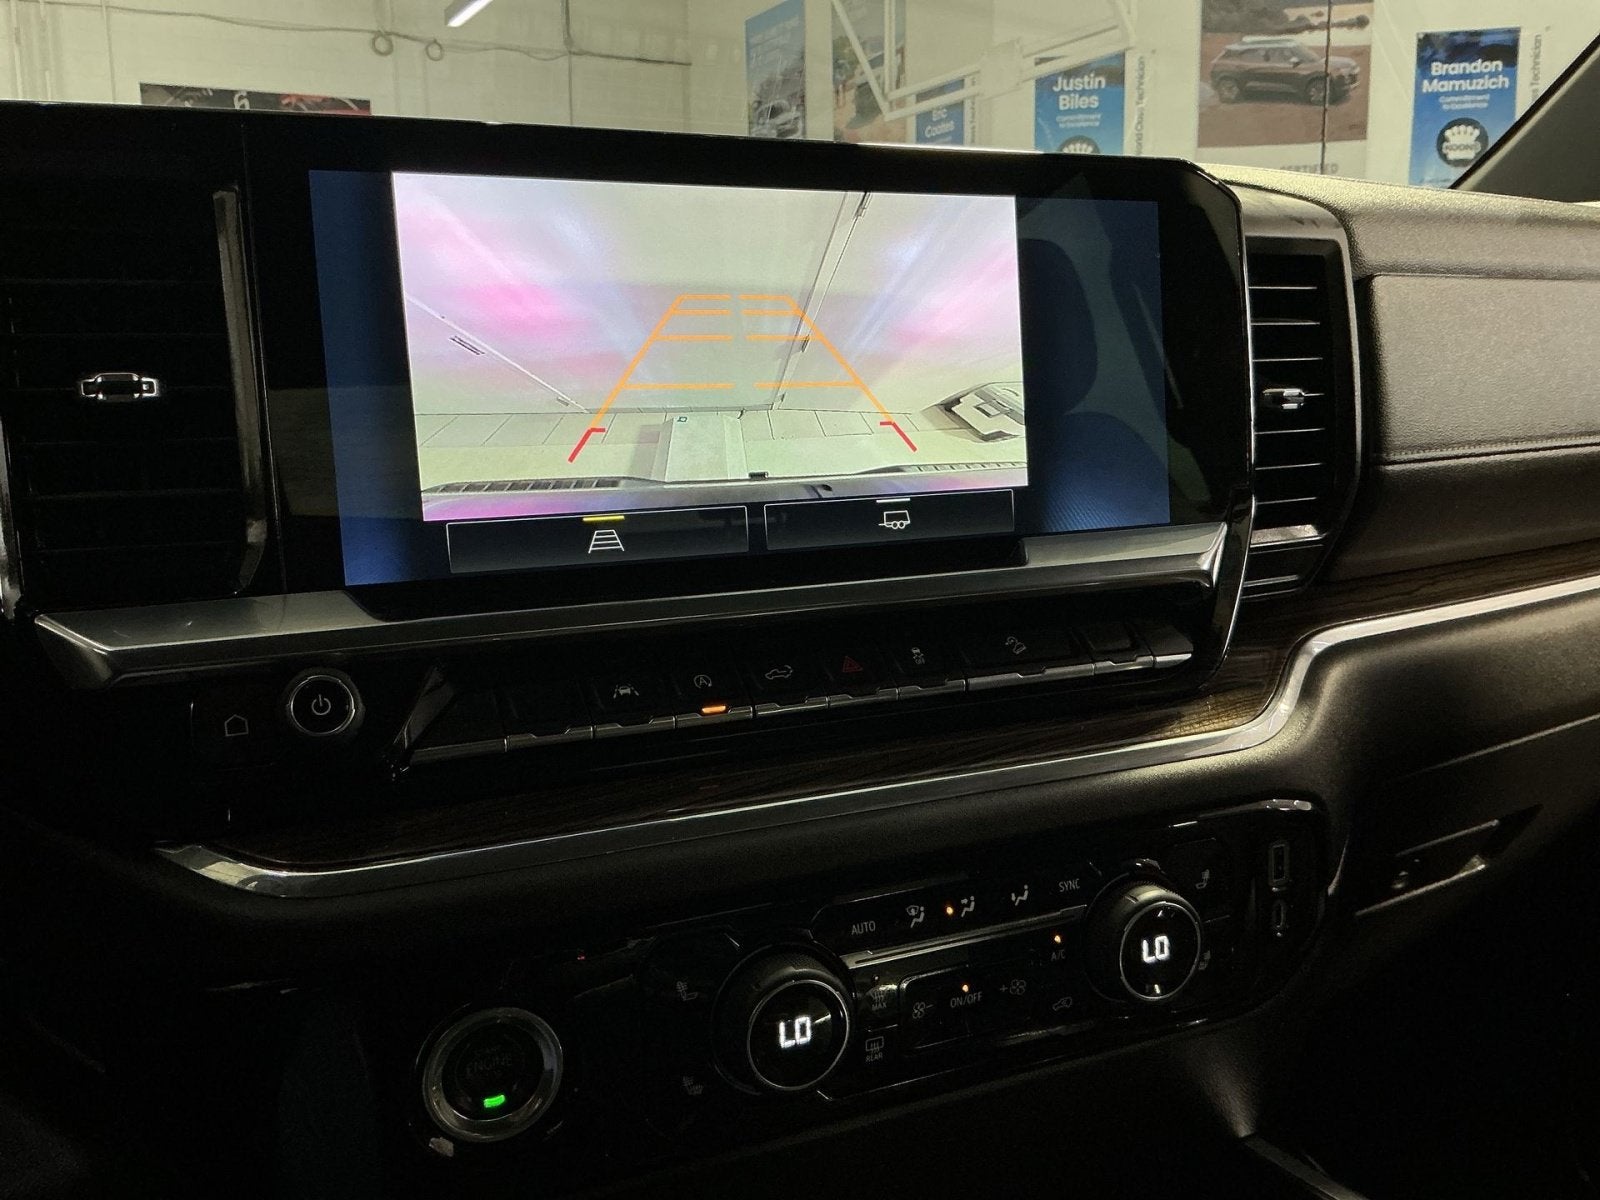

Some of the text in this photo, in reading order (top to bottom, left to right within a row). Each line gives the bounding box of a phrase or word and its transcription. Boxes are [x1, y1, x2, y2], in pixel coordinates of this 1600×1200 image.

[1430, 59, 1503, 76] Brandon
[1052, 71, 1106, 91] Justin
[1422, 75, 1510, 93] Mamuzich
[1058, 93, 1100, 111] Biles
[1058, 878, 1081, 893] SYNC
[851, 920, 876, 936] AUTO
[950, 990, 984, 1008] ON/OFF
